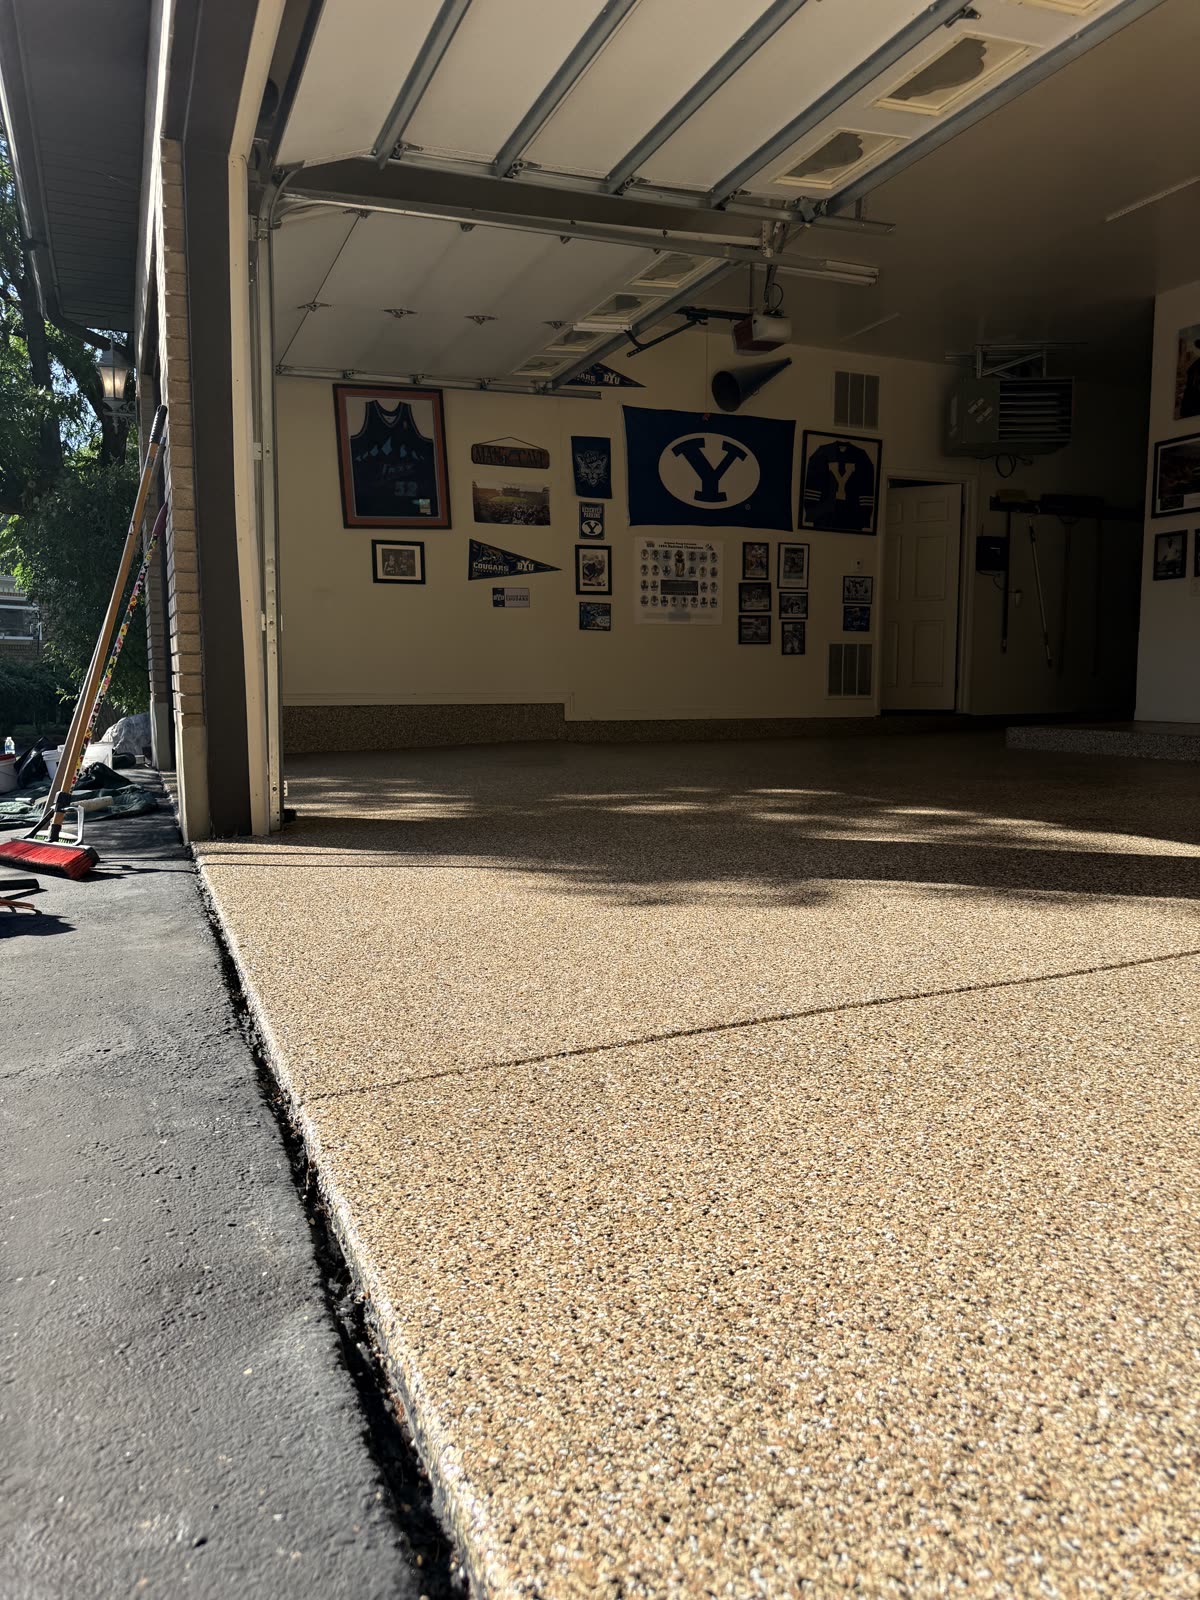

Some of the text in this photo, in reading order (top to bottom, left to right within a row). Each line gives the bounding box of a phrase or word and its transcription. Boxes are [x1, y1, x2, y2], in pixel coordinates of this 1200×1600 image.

[604, 372, 620, 384] BYU
[671, 437, 748, 503] Y
[826, 462, 857, 501] Y
[584, 521, 600, 534] Y
[473, 561, 509, 572] COUGARS
[517, 559, 535, 571] BYU
